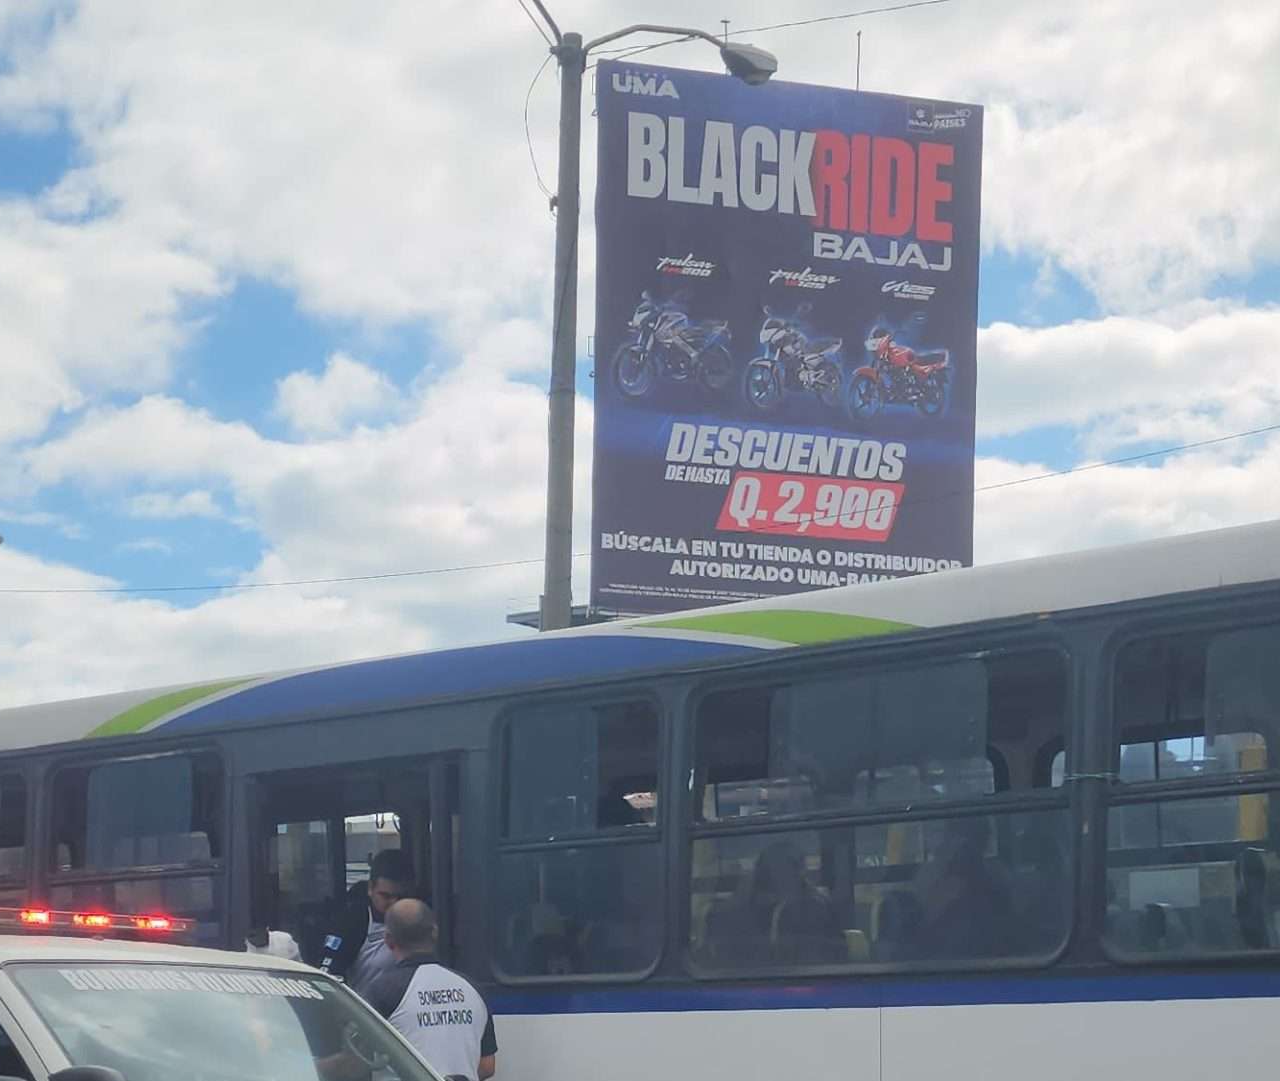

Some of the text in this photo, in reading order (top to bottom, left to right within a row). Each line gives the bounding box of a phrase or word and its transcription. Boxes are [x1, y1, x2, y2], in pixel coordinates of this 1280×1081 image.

[612, 73, 680, 99] UMA
[813, 231, 953, 272] BAJAJ
[665, 422, 907, 482] DESCUENTOS
[664, 464, 731, 486] DE HASTA
[773, 480, 896, 533] 2,900
[601, 531, 690, 555] BÚSCALA
[692, 540, 717, 557] EN
[720, 542, 745, 560] TU
[747, 543, 814, 565] TIENDA
[817, 549, 832, 567] O
[670, 559, 794, 583] AUTORIZADO
[418, 988, 465, 1006] BOMBEROS
[416, 1009, 473, 1028] VOLUNTARIOS
